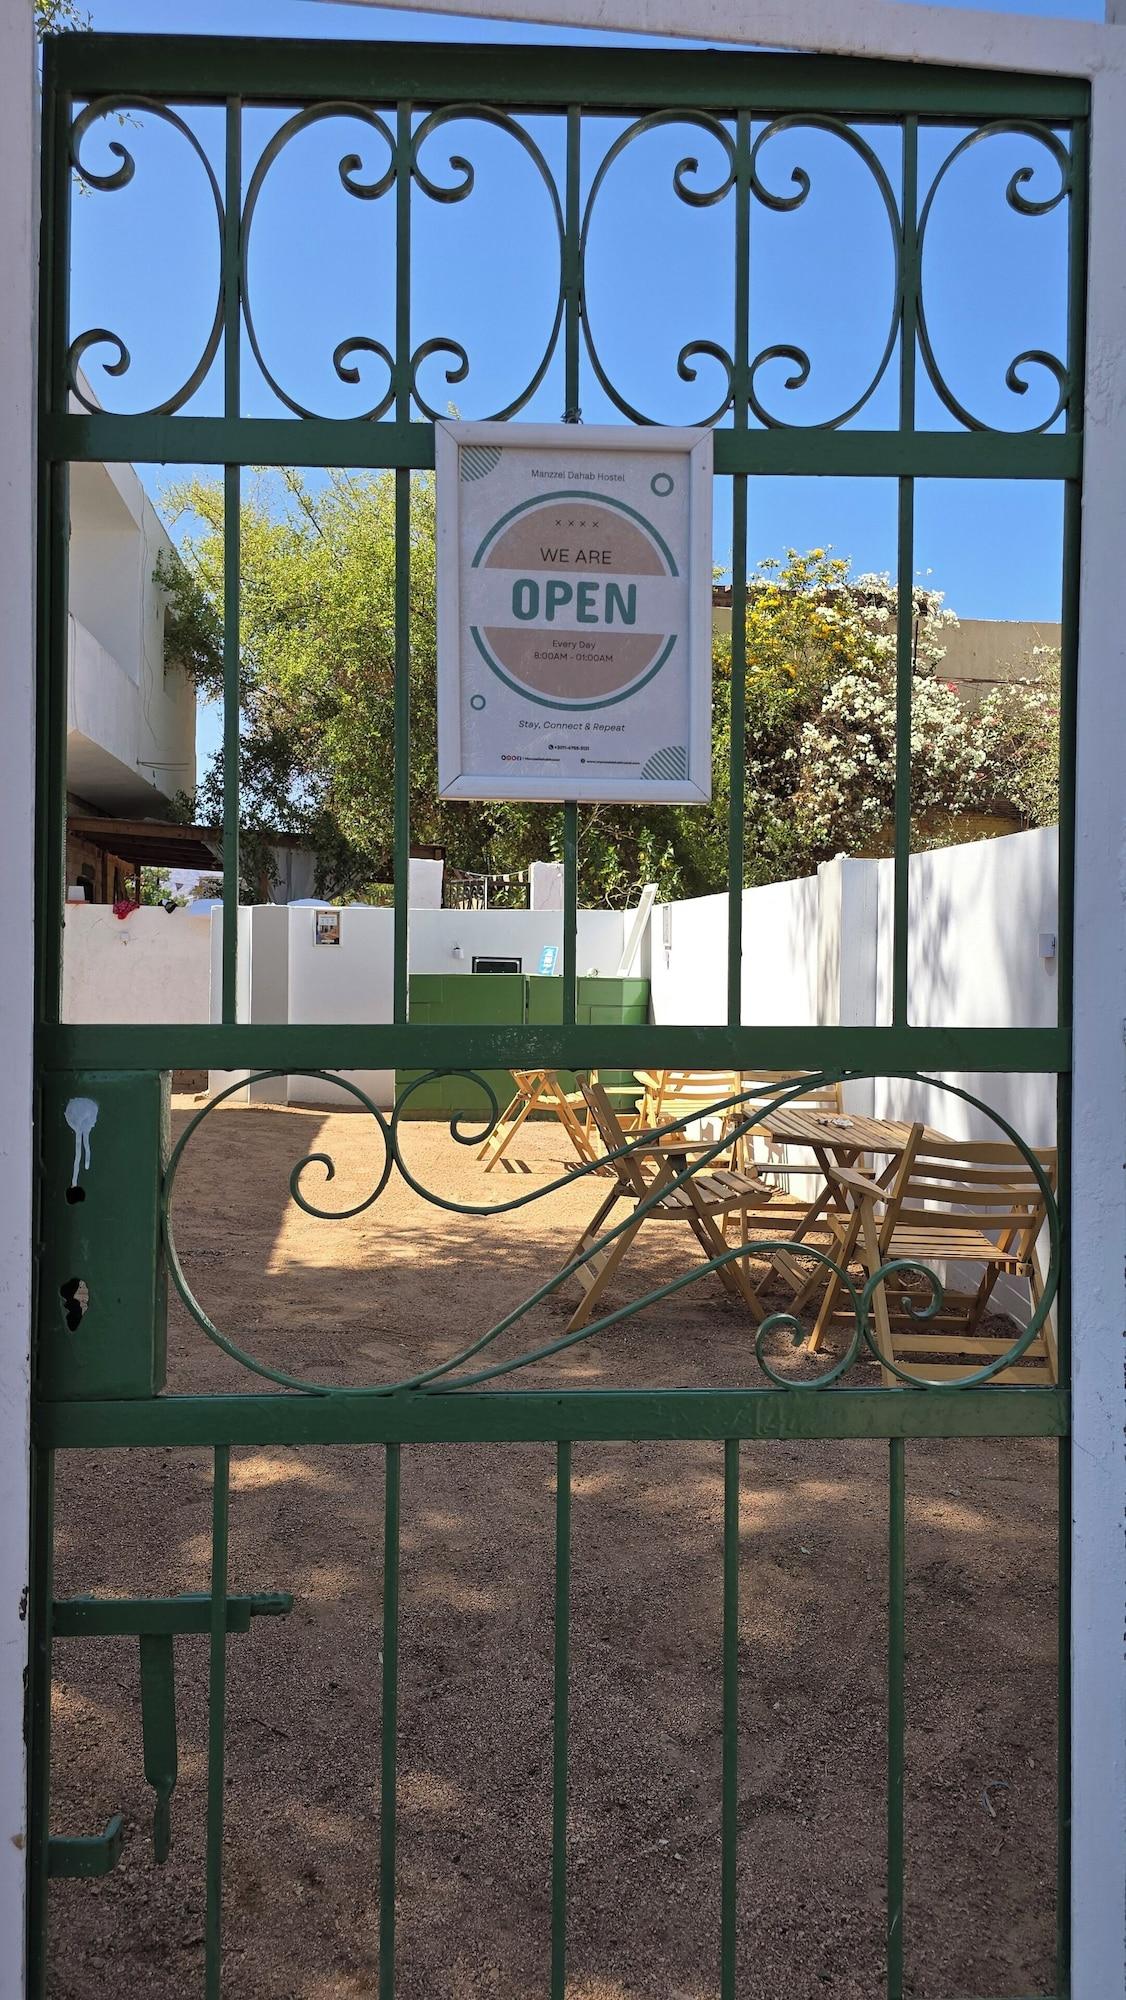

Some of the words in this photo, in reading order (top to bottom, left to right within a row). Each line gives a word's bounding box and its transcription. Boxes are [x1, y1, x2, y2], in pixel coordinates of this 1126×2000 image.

[567, 471, 596, 480] Dahab
[598, 472, 625, 482] Hostel
[540, 547, 570, 562] WE
[575, 550, 612, 564] ARE
[512, 578, 637, 625] OPEN
[552, 640, 576, 649] Every
[579, 641, 596, 650] Day
[534, 652, 568, 660] 8:00AM
[576, 653, 613, 662] 01:00AM
[543, 721, 583, 730] Connect
[593, 723, 625, 733] Repeat
